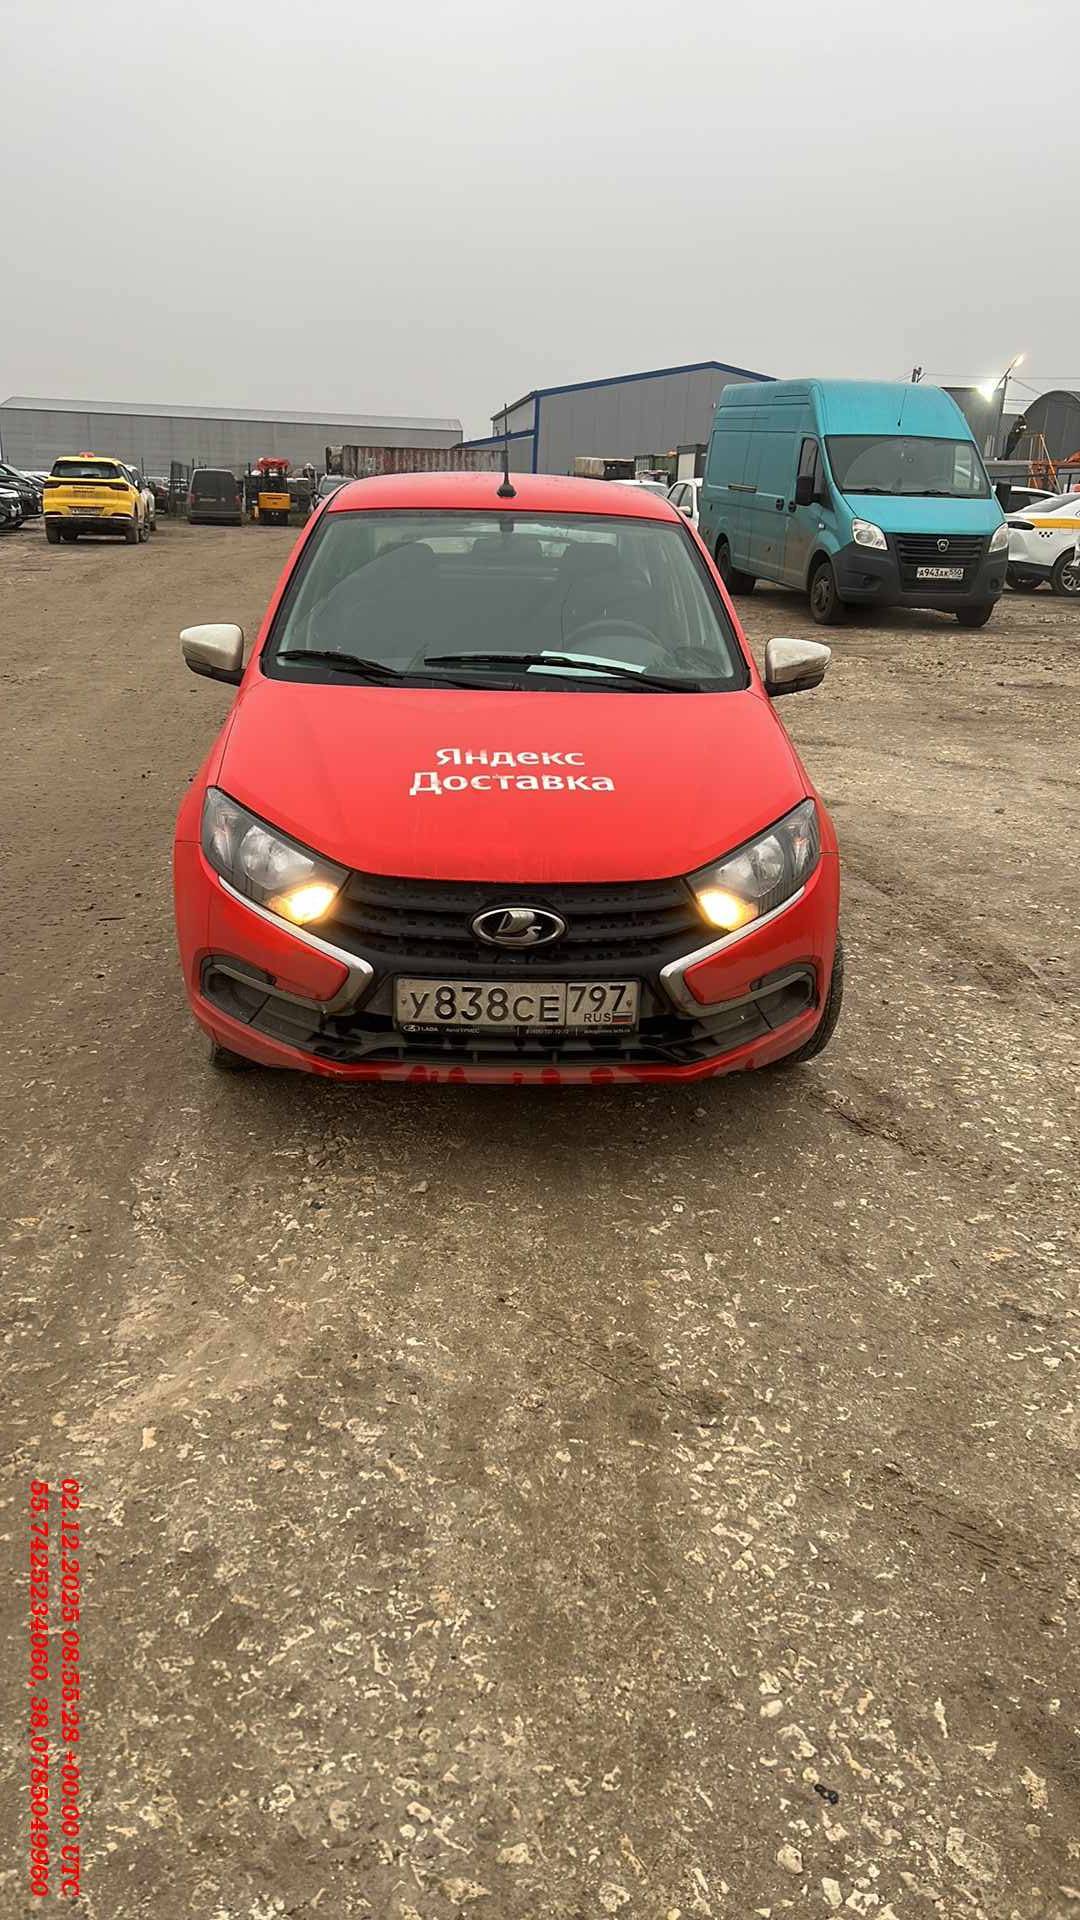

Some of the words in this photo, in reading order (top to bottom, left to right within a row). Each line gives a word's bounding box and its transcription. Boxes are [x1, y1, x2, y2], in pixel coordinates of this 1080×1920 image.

[435, 748, 585, 767] Яндекс
[409, 772, 615, 796] Доставка
[410, 985, 560, 1022] У838СЕ
[569, 985, 627, 1013] 797
[584, 1013, 611, 1023] RUS
